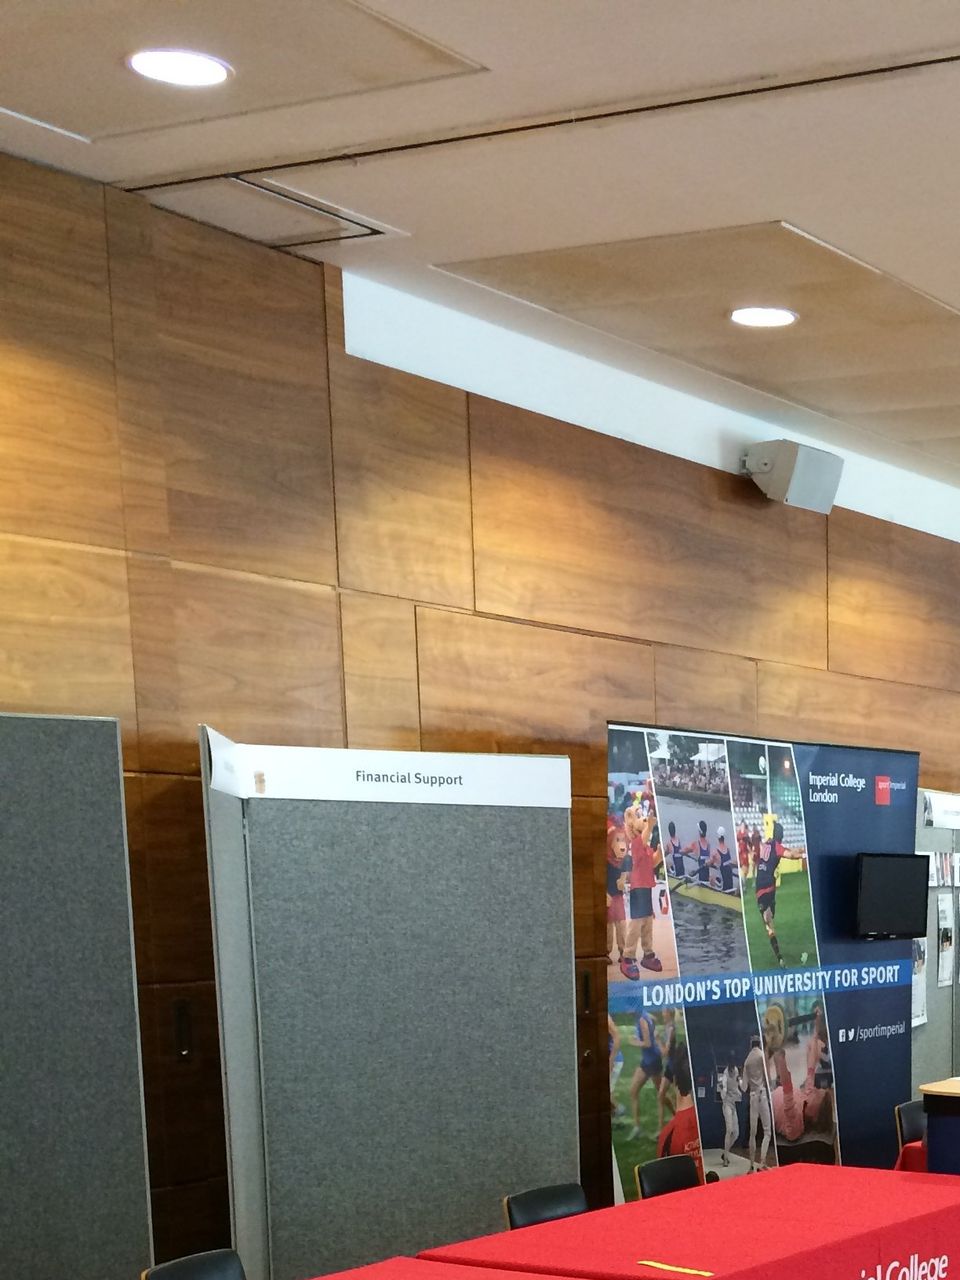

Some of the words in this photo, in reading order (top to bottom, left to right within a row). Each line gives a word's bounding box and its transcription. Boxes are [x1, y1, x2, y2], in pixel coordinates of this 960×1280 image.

[355, 770, 412, 784] Financial
[414, 772, 464, 787] Support
[809, 771, 838, 789] Imperial
[840, 773, 866, 792] College
[809, 789, 839, 803] London
[642, 978, 721, 1007] LONDON'S
[723, 976, 751, 997] TOP
[754, 970, 833, 996] UNIVERSITY
[835, 968, 859, 988] FOR
[861, 965, 900, 986] SPORT
